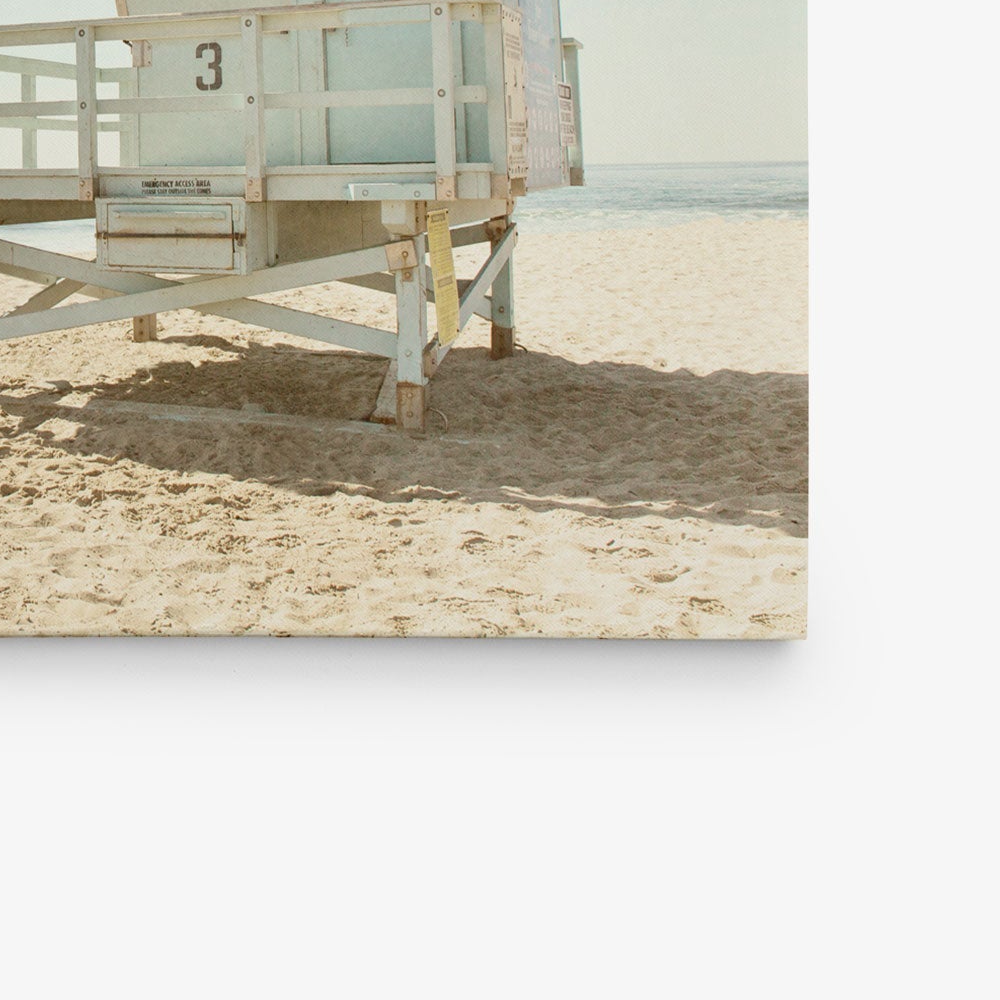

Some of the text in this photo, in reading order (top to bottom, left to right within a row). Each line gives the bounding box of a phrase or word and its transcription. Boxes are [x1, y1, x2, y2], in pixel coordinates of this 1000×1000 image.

[195, 41, 223, 91] 3
[141, 179, 211, 188] EMERGENCY ACCESS AREA
